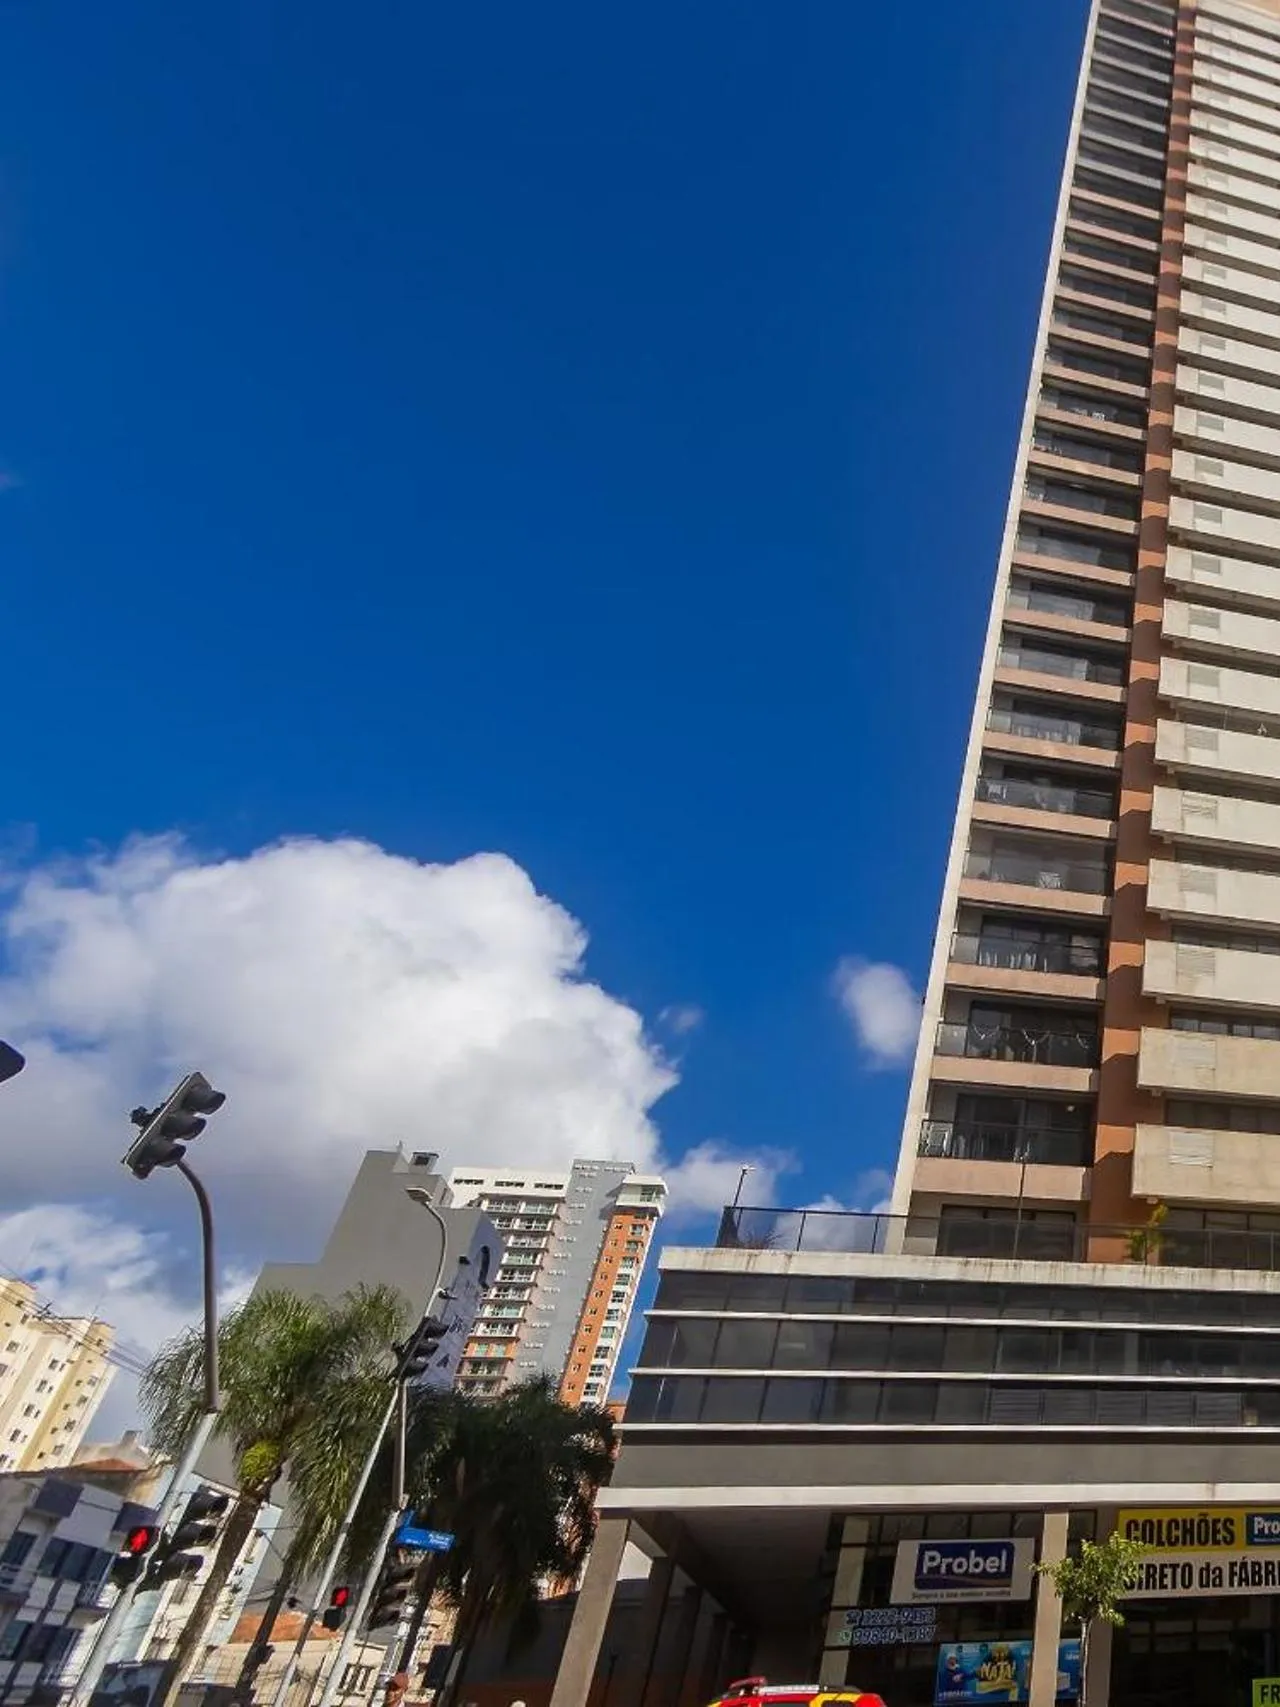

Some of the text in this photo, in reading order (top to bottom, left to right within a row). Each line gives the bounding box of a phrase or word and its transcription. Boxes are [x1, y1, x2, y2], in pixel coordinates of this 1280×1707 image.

[1125, 1513, 1235, 1548] COLCHÕES
[922, 1549, 1007, 1575] Probel
[1199, 1562, 1224, 1589] da
